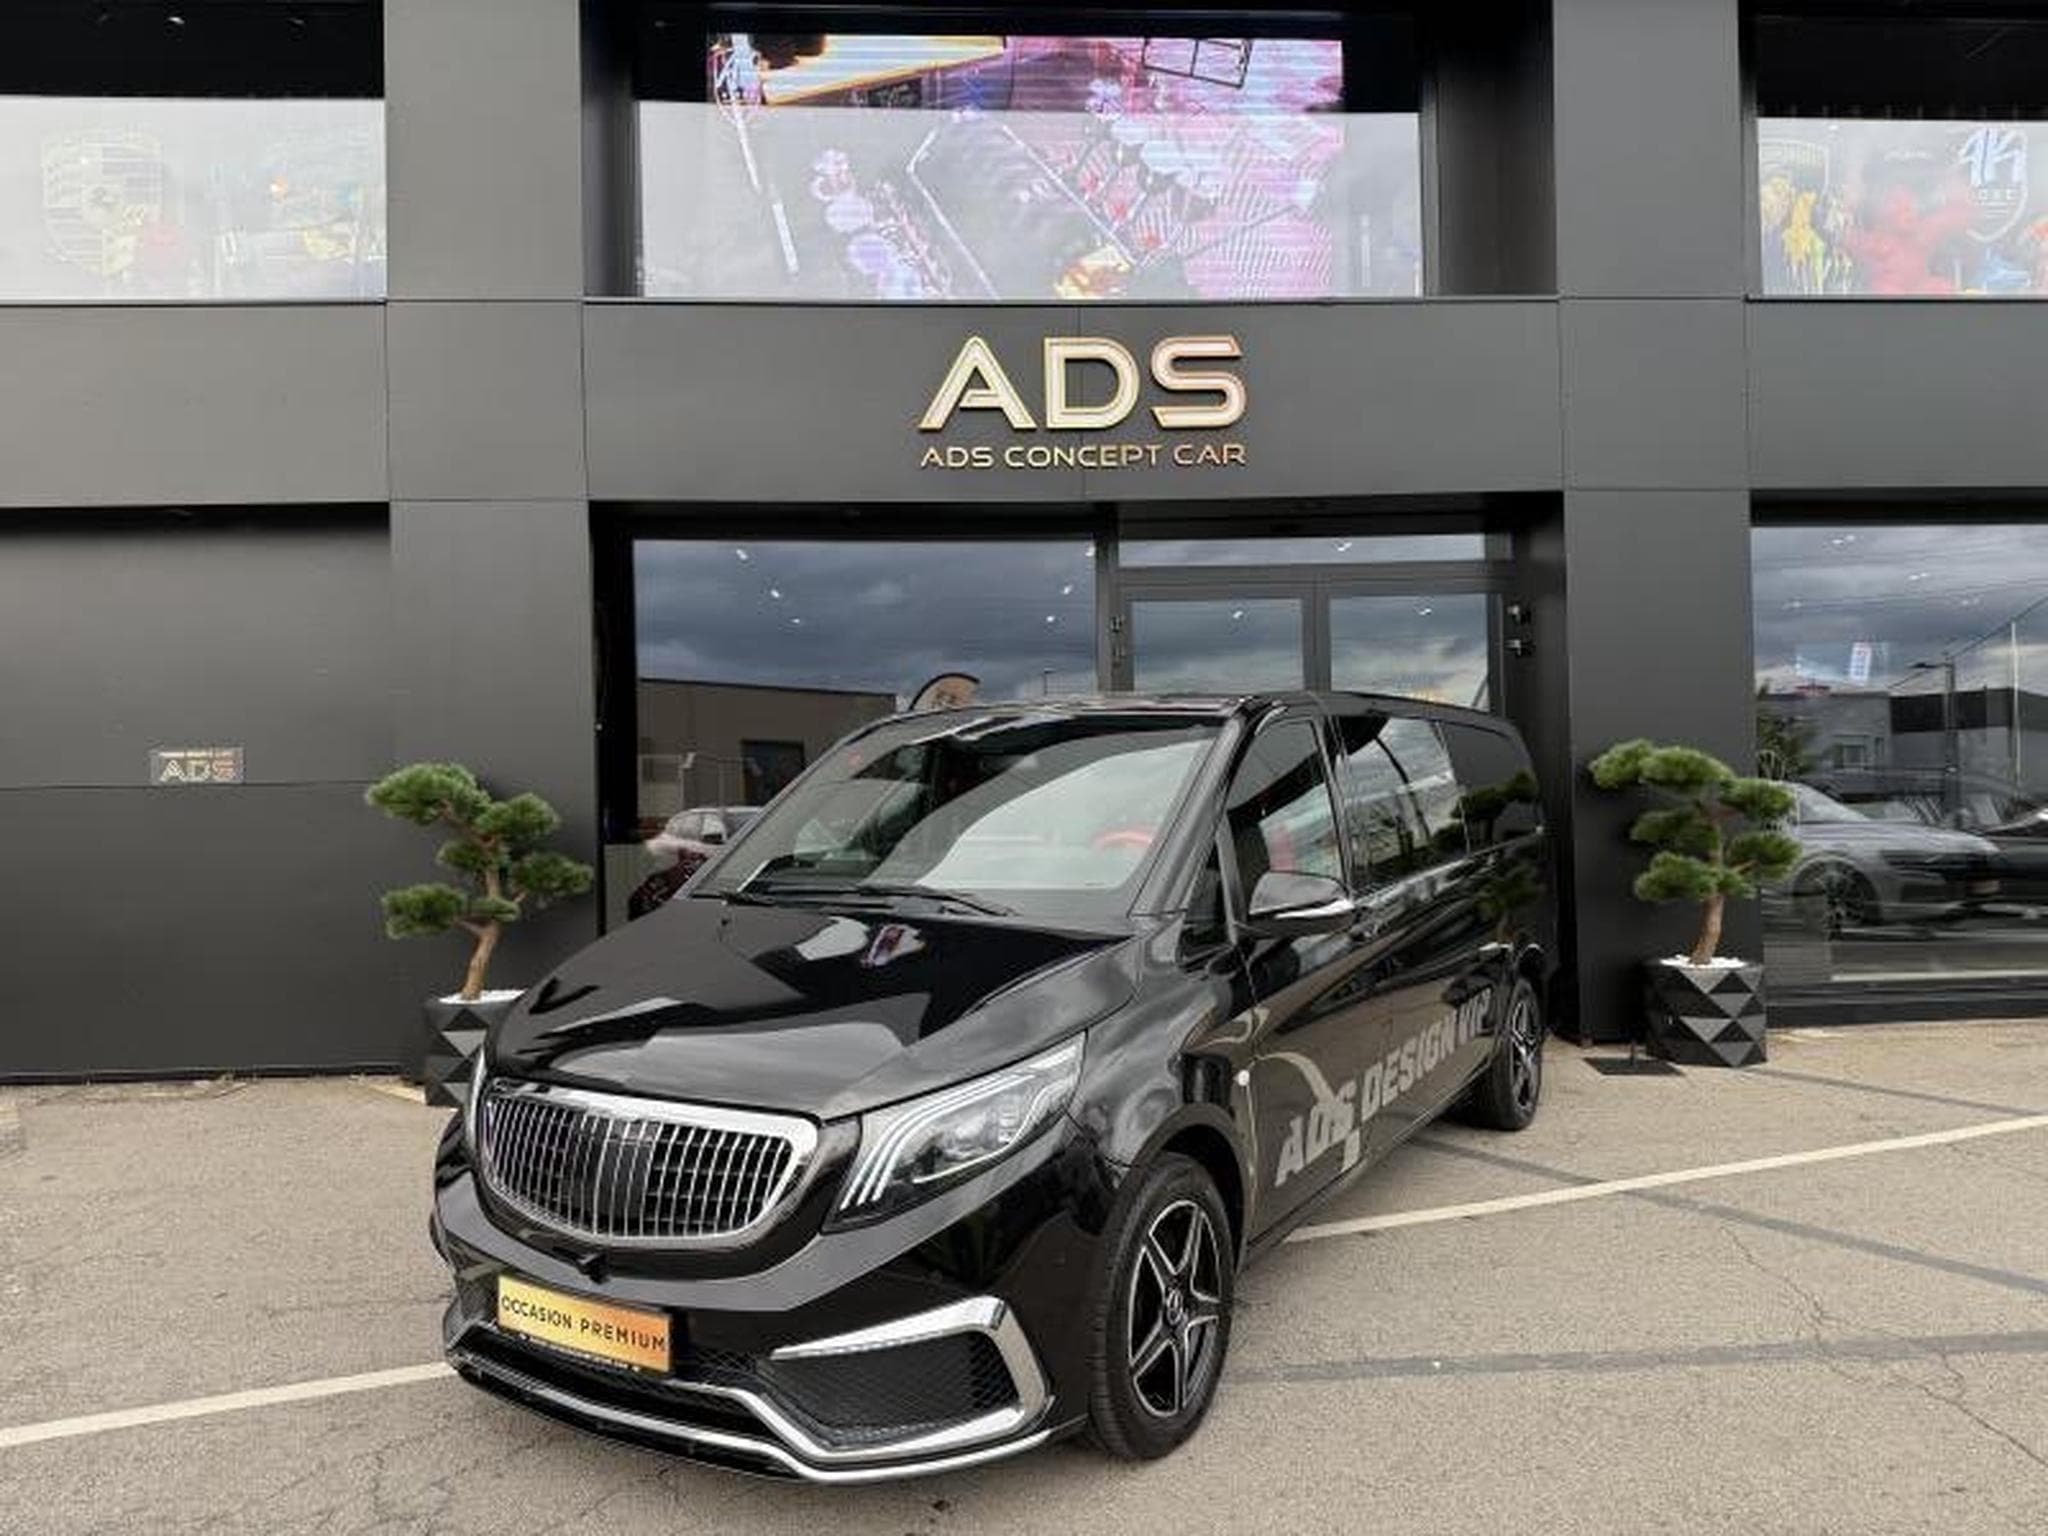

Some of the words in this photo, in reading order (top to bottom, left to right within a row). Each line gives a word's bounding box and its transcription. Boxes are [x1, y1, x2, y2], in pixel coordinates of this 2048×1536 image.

[918, 335, 1247, 430] ADS
[921, 447, 994, 468] ADS
[1004, 446, 1161, 468] CONCEPT
[1173, 444, 1246, 466] CAR
[159, 759, 235, 782] ADS
[1360, 1009, 1457, 1122] DESIGN
[502, 1296, 572, 1329] OCCASION
[580, 1319, 666, 1350] PREMIUM
